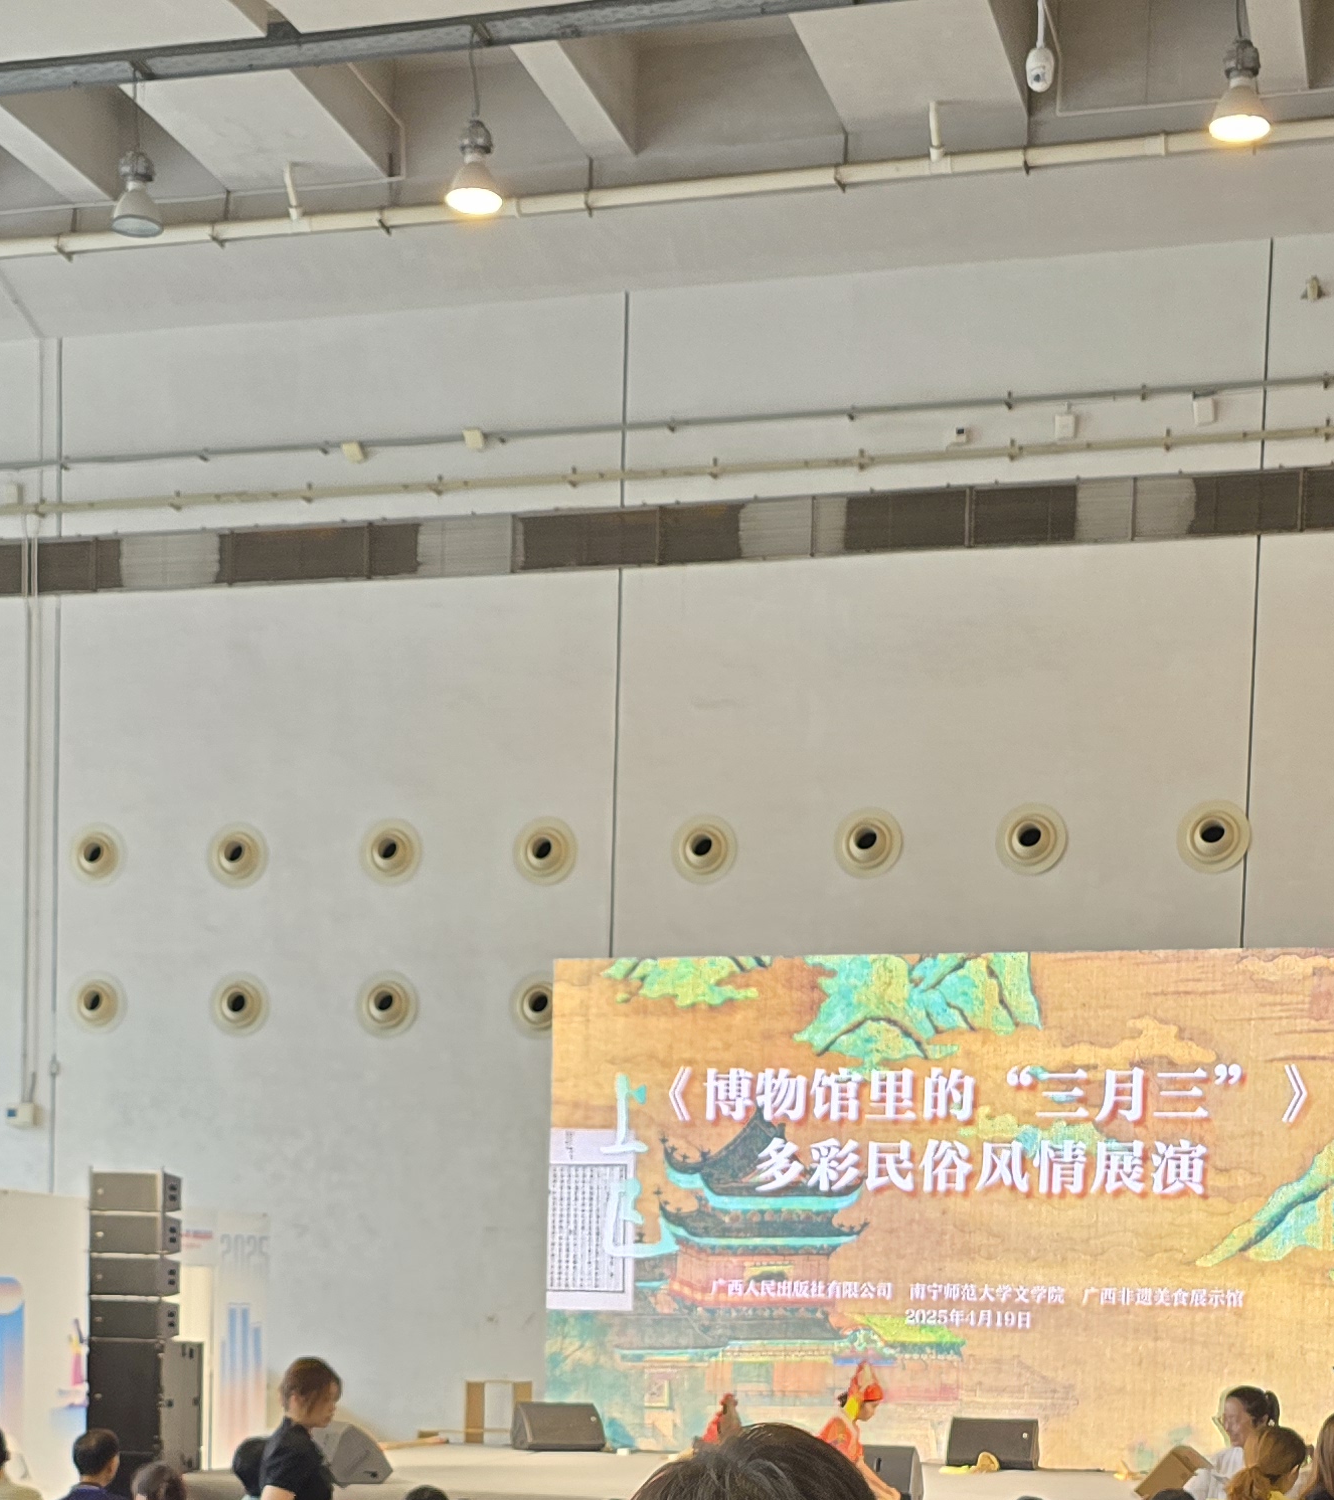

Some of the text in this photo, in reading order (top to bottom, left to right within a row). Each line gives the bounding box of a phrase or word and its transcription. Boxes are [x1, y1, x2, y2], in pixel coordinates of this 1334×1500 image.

[754, 1139, 1208, 1196] 多彩民俗风情展演
[710, 1279, 1245, 1308] 广西人民出版社有限公司 南宁师范大学文学院 广西非遗美食展示馆
[905, 1308, 1032, 1329] 2025年4月19日
